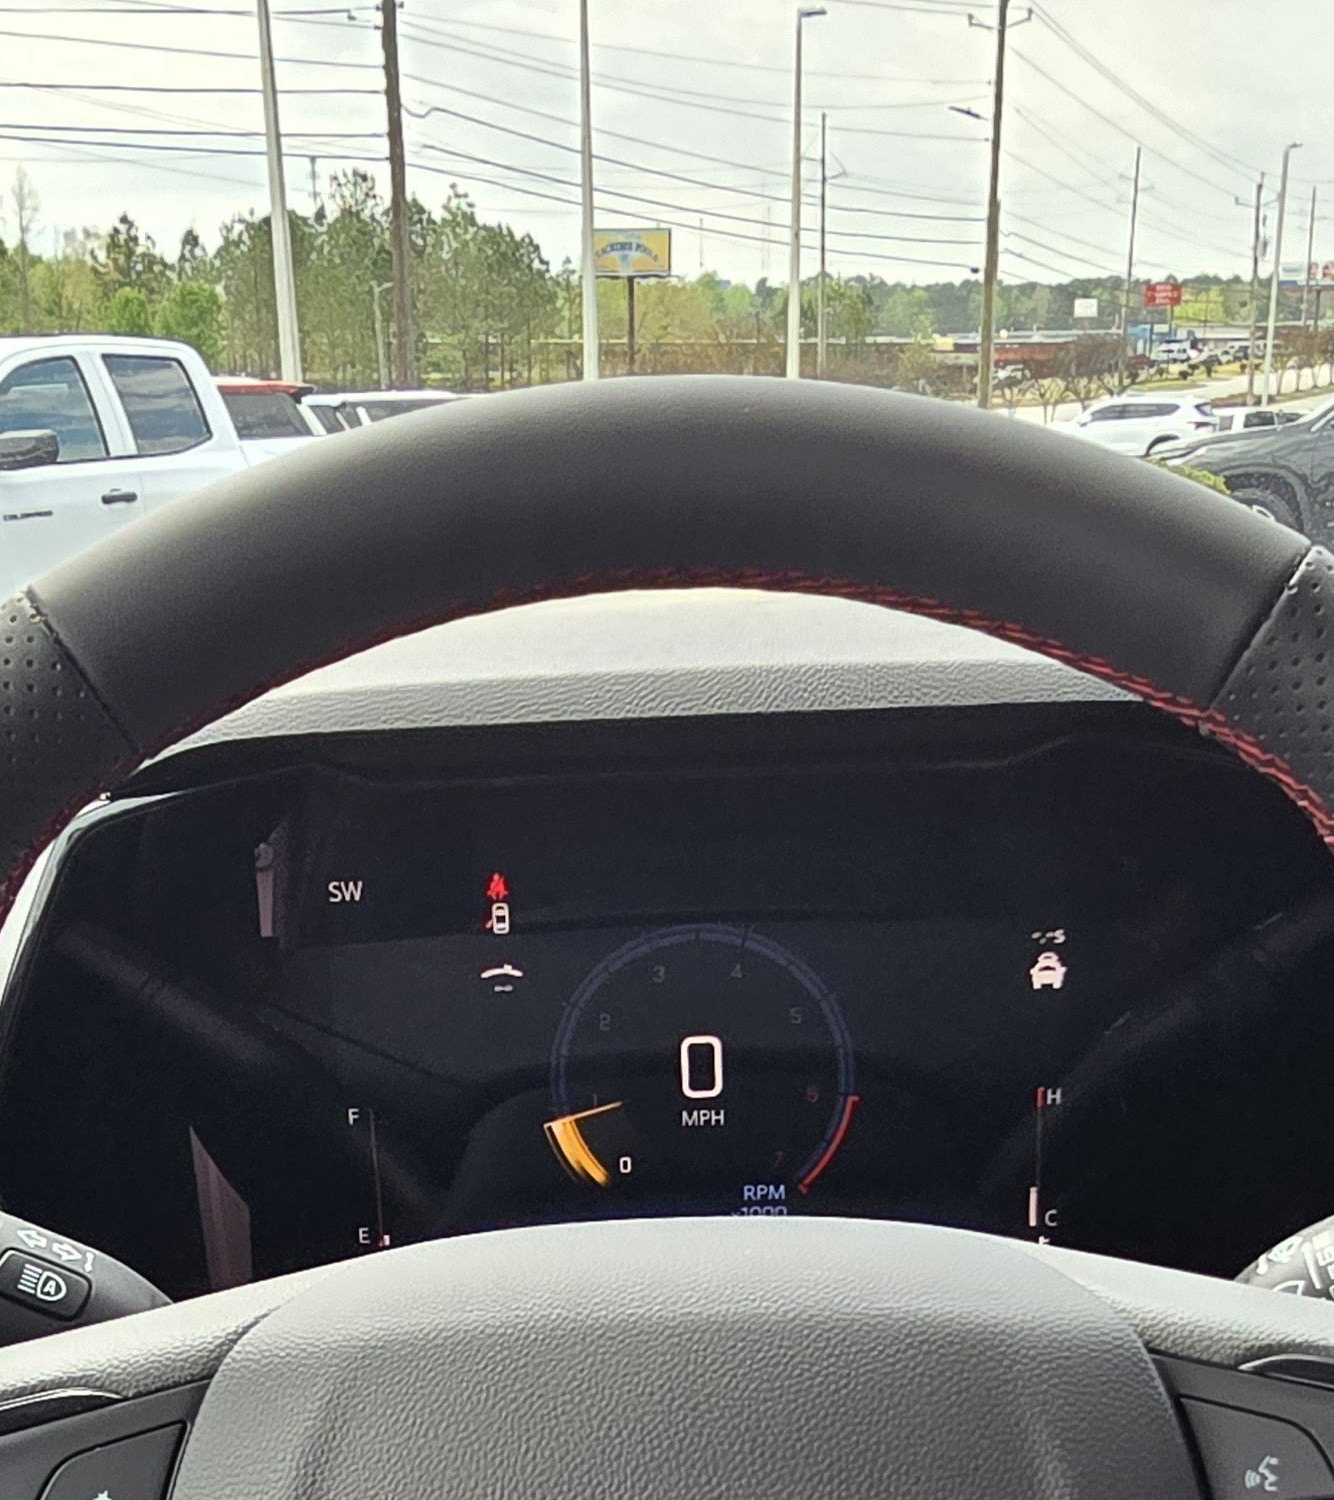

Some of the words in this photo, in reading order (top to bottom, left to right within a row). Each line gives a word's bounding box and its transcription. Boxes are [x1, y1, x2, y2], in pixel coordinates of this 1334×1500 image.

[328, 880, 363, 902] SW
[680, 1035, 723, 1099] 0
[1046, 1087, 1062, 1106] H
[348, 1108, 360, 1126] F
[681, 1109, 725, 1127] MPH
[619, 1156, 632, 1174] 0
[743, 1184, 786, 1201] RPM
[1044, 1208, 1058, 1227] C
[358, 1227, 371, 1244] E
